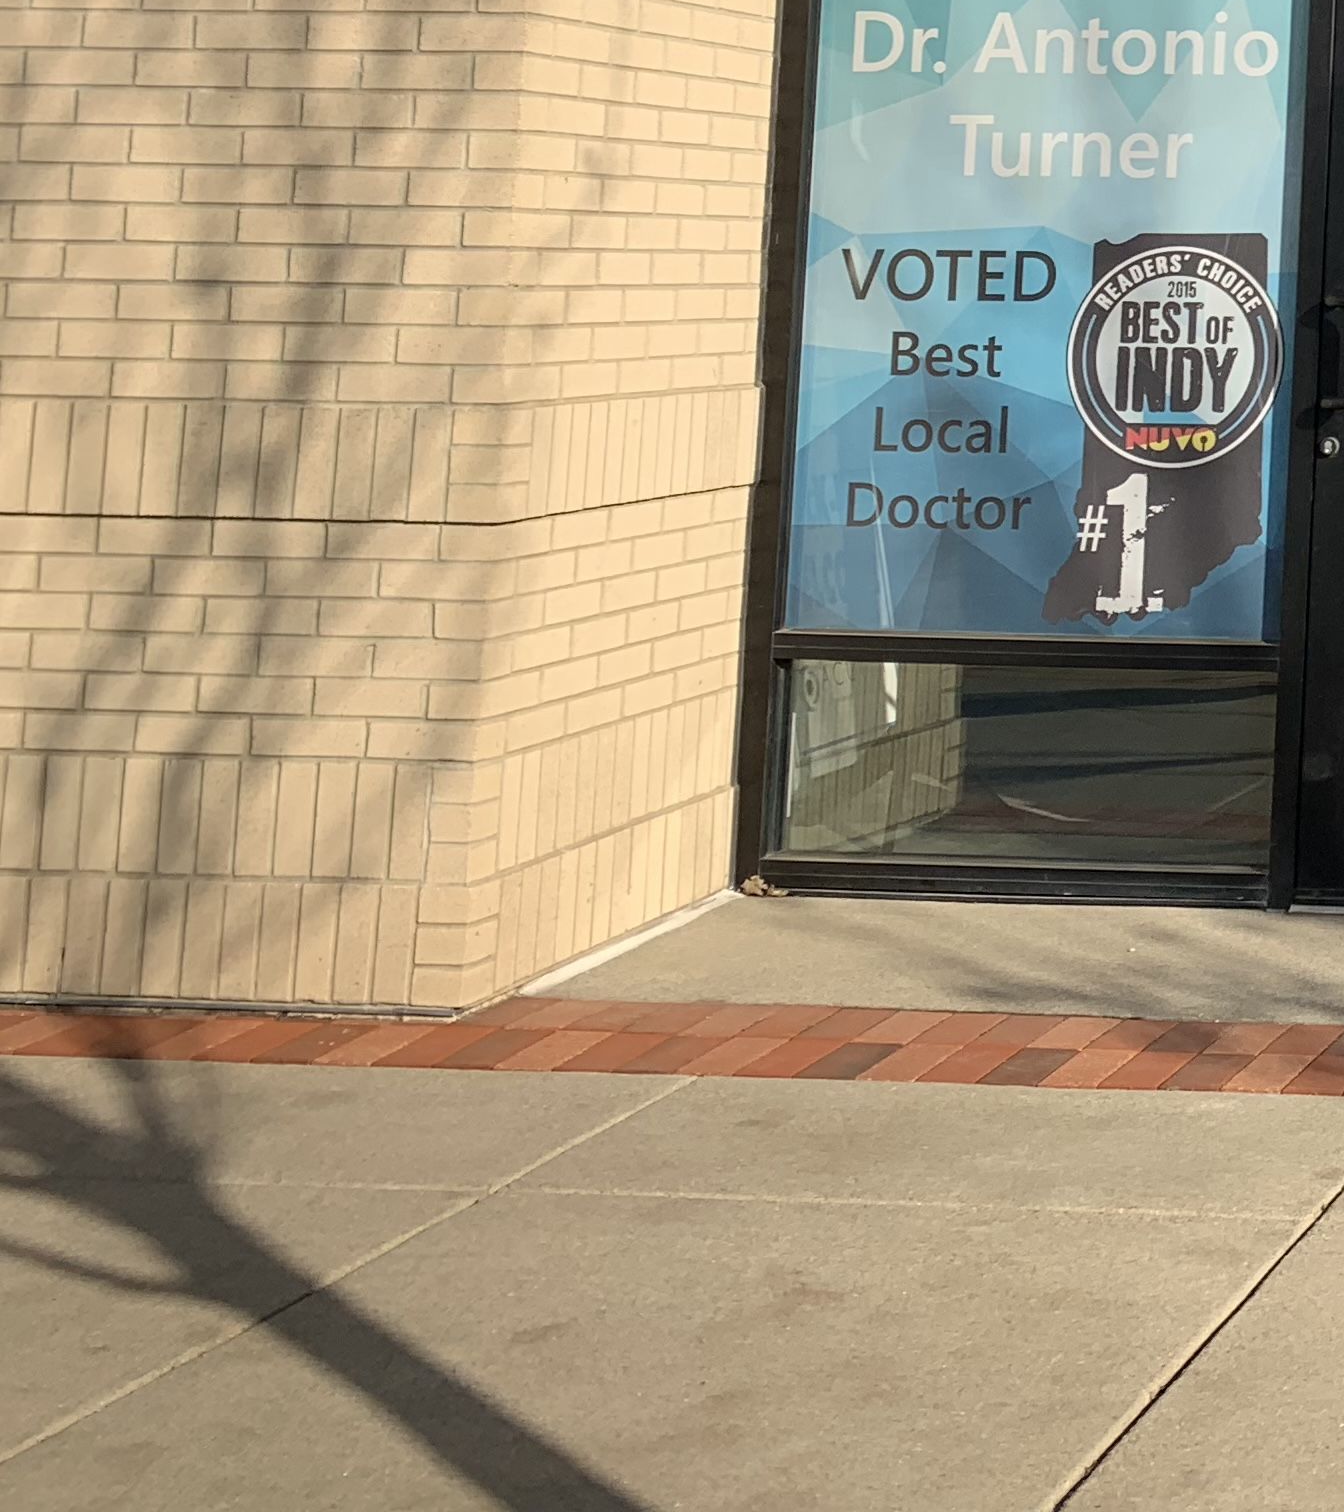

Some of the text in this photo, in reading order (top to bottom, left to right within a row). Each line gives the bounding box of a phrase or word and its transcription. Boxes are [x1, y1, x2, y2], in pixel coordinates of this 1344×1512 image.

[852, 11, 1278, 77] Dr. Antonio
[950, 114, 1193, 179] Turner
[842, 249, 1056, 301] VOTED
[1095, 254, 1262, 314] READERS' CHOICE
[1167, 281, 1197, 298] 2015
[1120, 301, 1234, 344] BEST OF
[890, 331, 1003, 378] Best
[1115, 347, 1238, 413] INDY
[873, 405, 1009, 454] Local
[1125, 427, 1216, 452] NUVO
[845, 482, 1032, 530] Doctor
